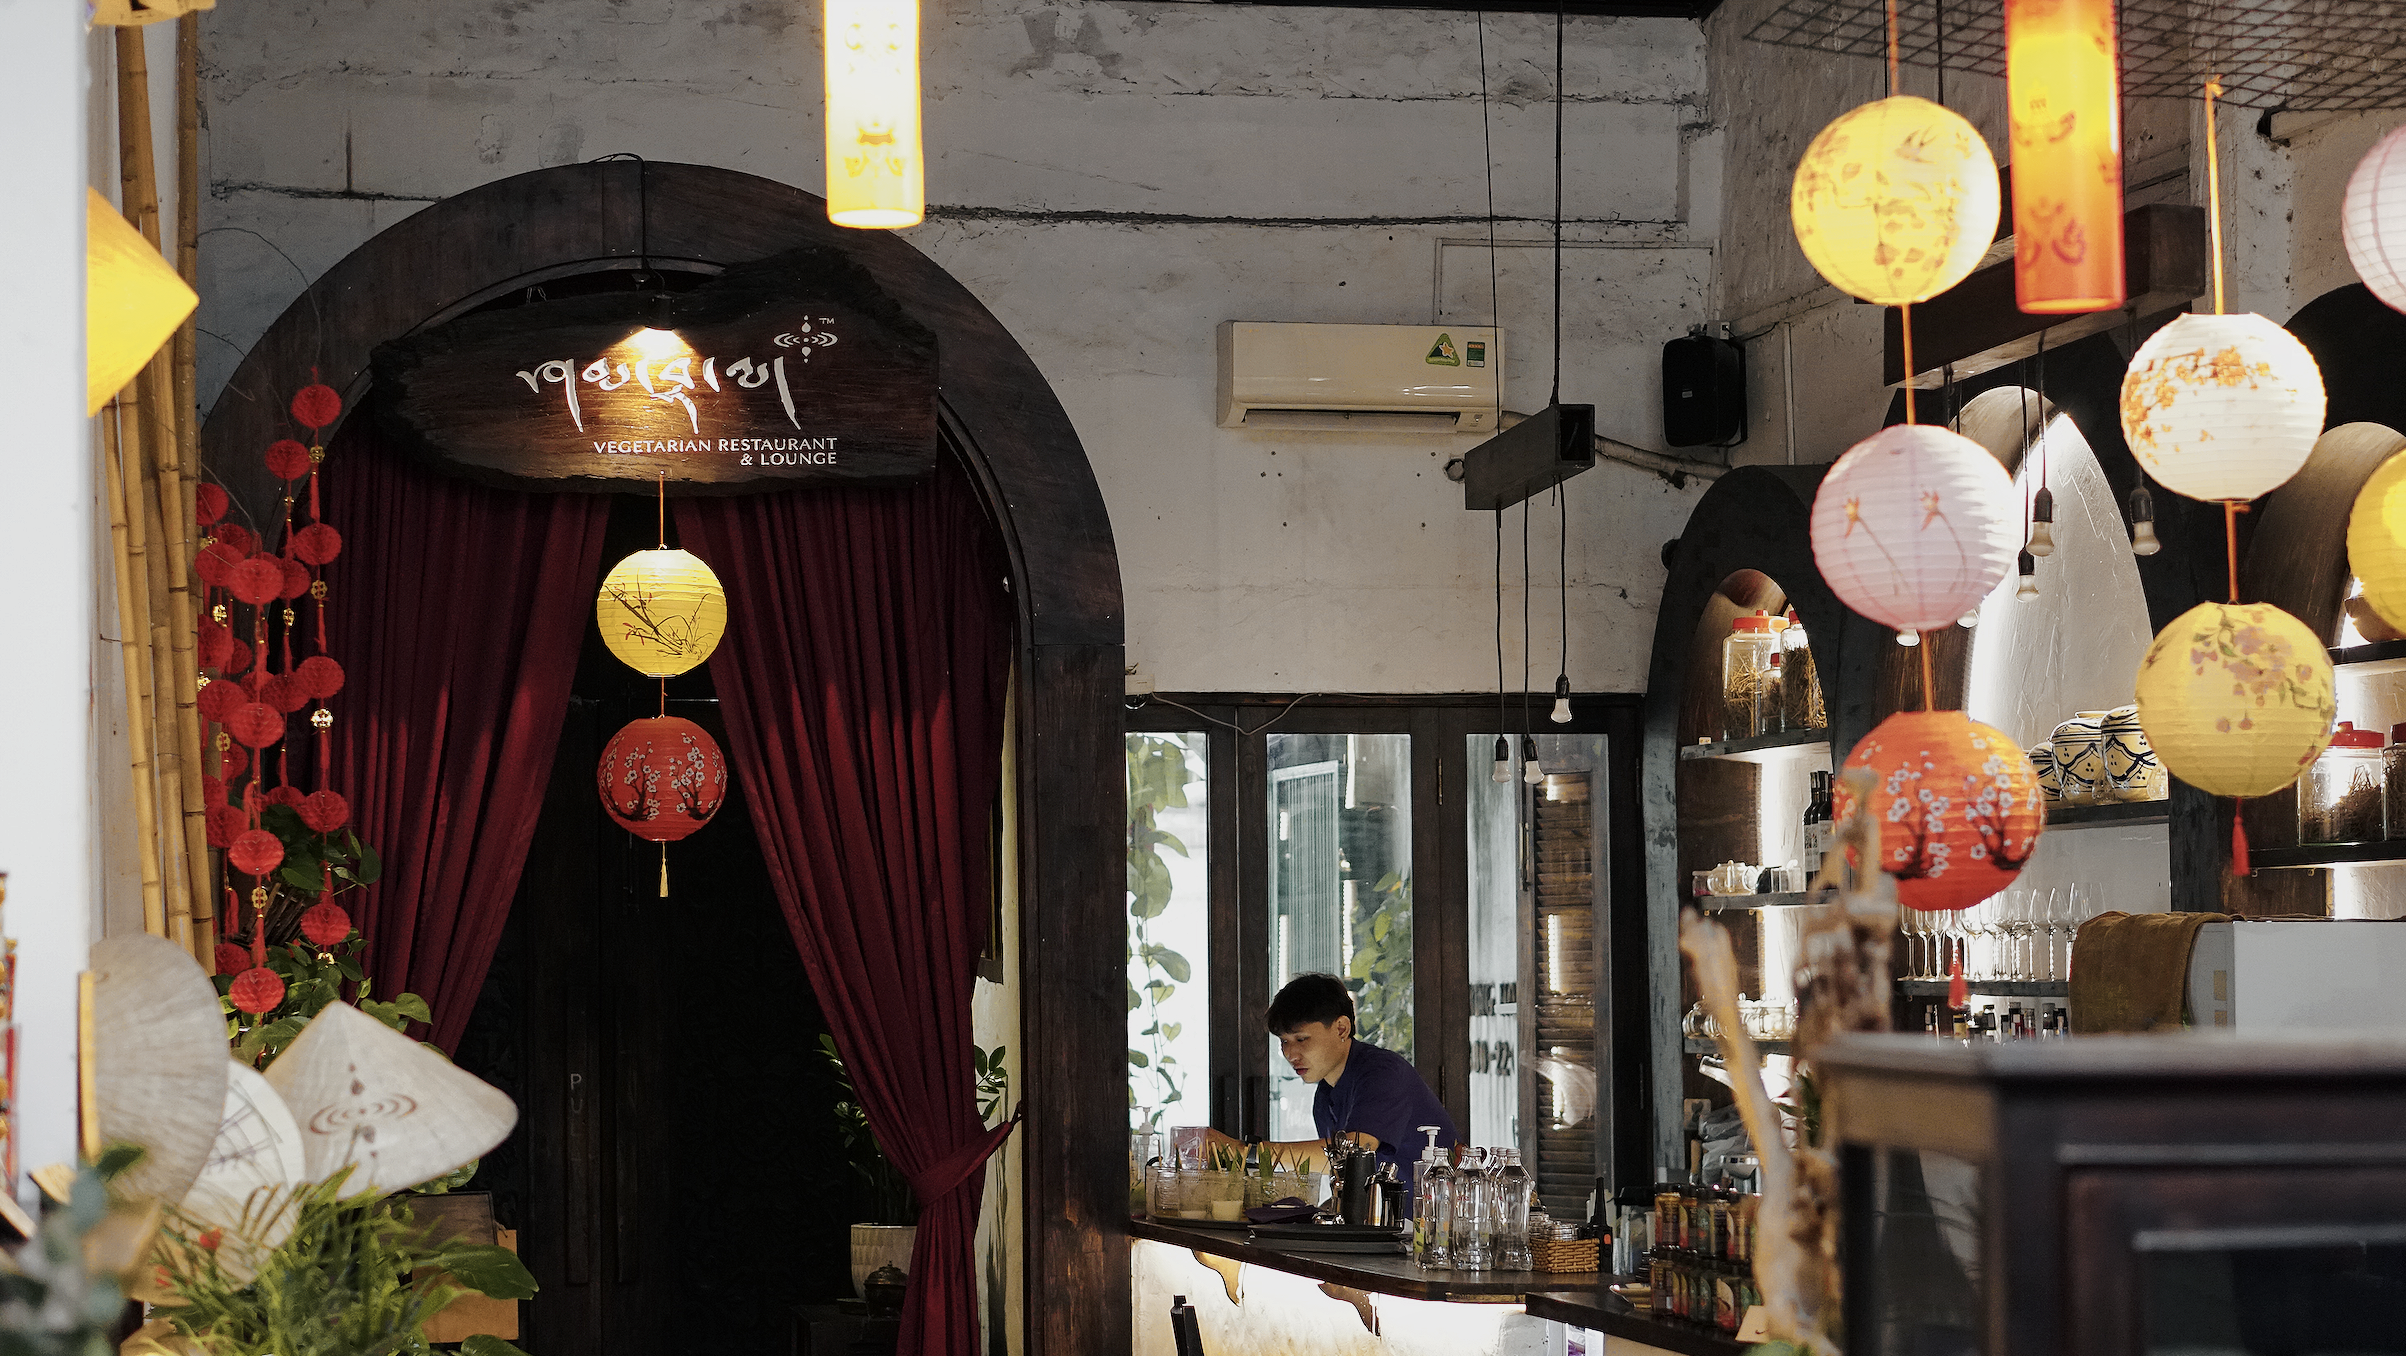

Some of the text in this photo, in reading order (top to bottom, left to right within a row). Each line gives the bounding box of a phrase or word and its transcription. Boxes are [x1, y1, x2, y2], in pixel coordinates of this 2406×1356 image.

[593, 437, 838, 454] VEGETARIAN RESTAURANT
[739, 452, 837, 466] & LOUNGE
